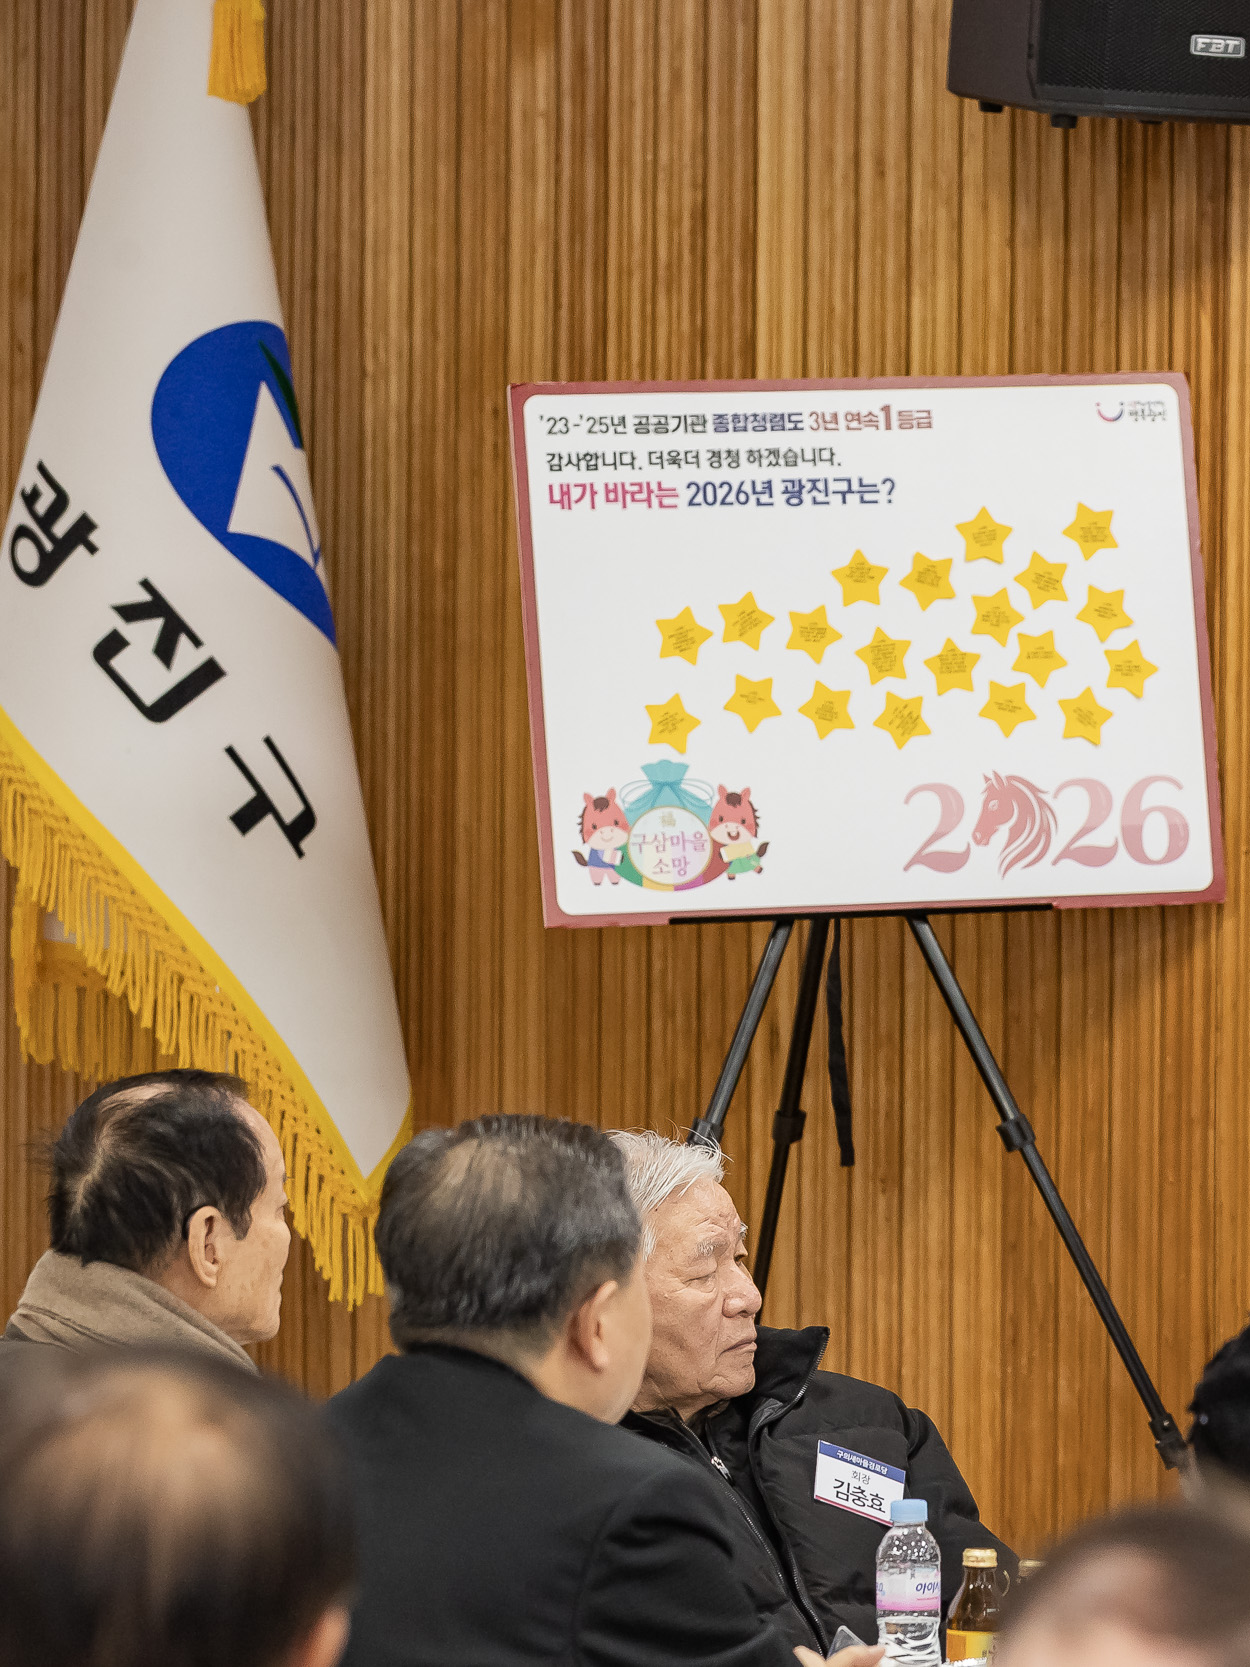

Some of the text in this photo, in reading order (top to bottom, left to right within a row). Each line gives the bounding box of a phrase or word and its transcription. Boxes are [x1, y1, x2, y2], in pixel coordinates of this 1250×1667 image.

[1196, 37, 1240, 53] FBT
[633, 413, 707, 435] 공공기관
[713, 411, 804, 433] 종합청렴도
[809, 410, 839, 431] 3년
[547, 446, 841, 472] 감사합니다. 더욱더 경청 하겠습니다.
[548, 475, 896, 510] 내가 바라는 2026년 광진구는?
[9, 459, 317, 859] 광진구
[652, 855, 690, 877] 소망
[851, 1470, 871, 1485] 회장
[833, 1478, 886, 1514] 김충효
